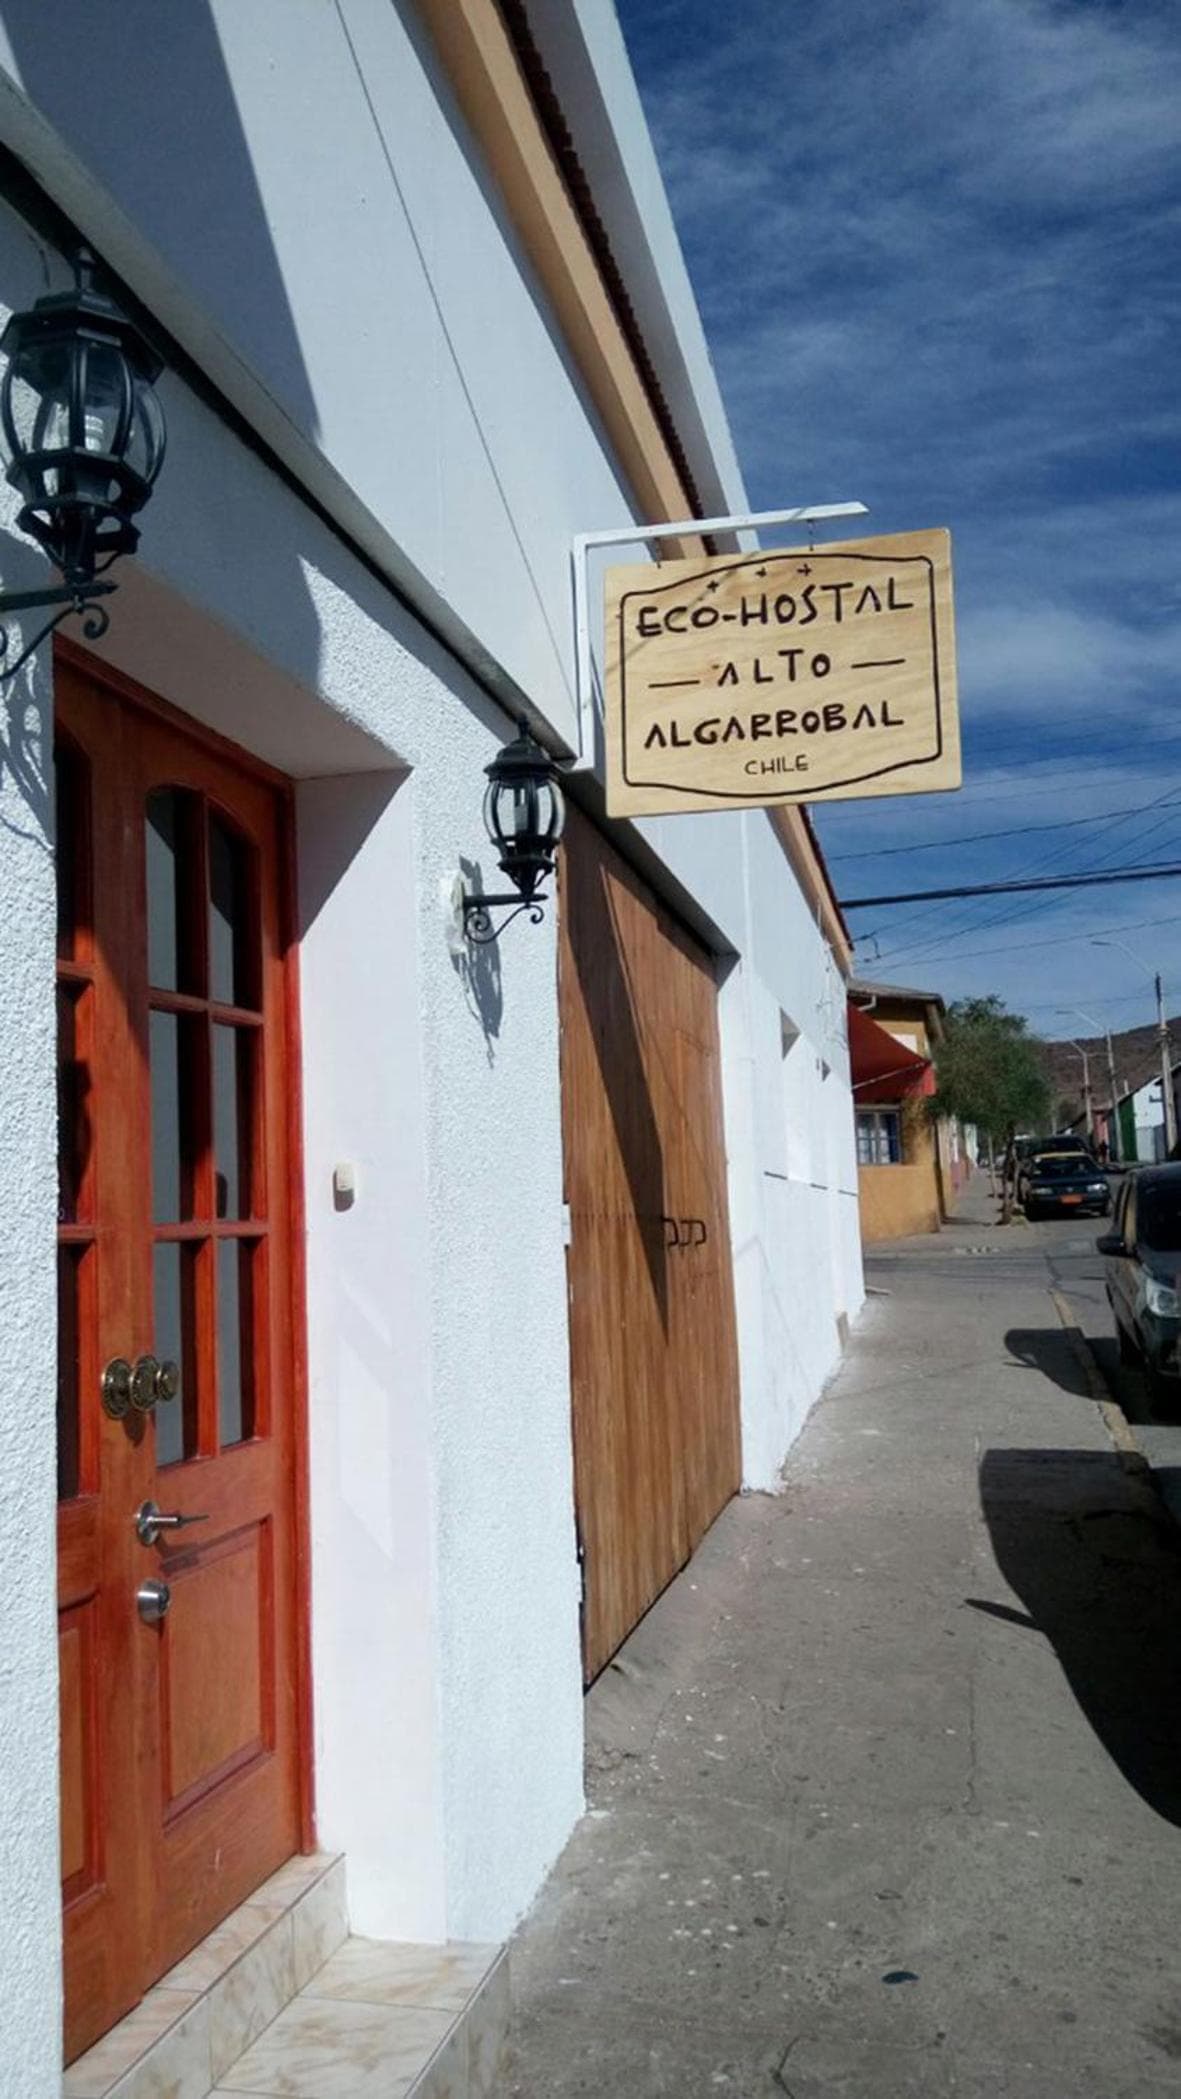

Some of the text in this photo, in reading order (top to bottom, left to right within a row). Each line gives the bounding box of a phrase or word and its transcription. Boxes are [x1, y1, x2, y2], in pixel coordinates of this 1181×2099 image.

[636, 577, 914, 637] ECO-HOSTAL
[718, 649, 831, 687] ALTO
[644, 701, 904, 749] ALGARROBAL
[744, 754, 809, 775] CHILE
